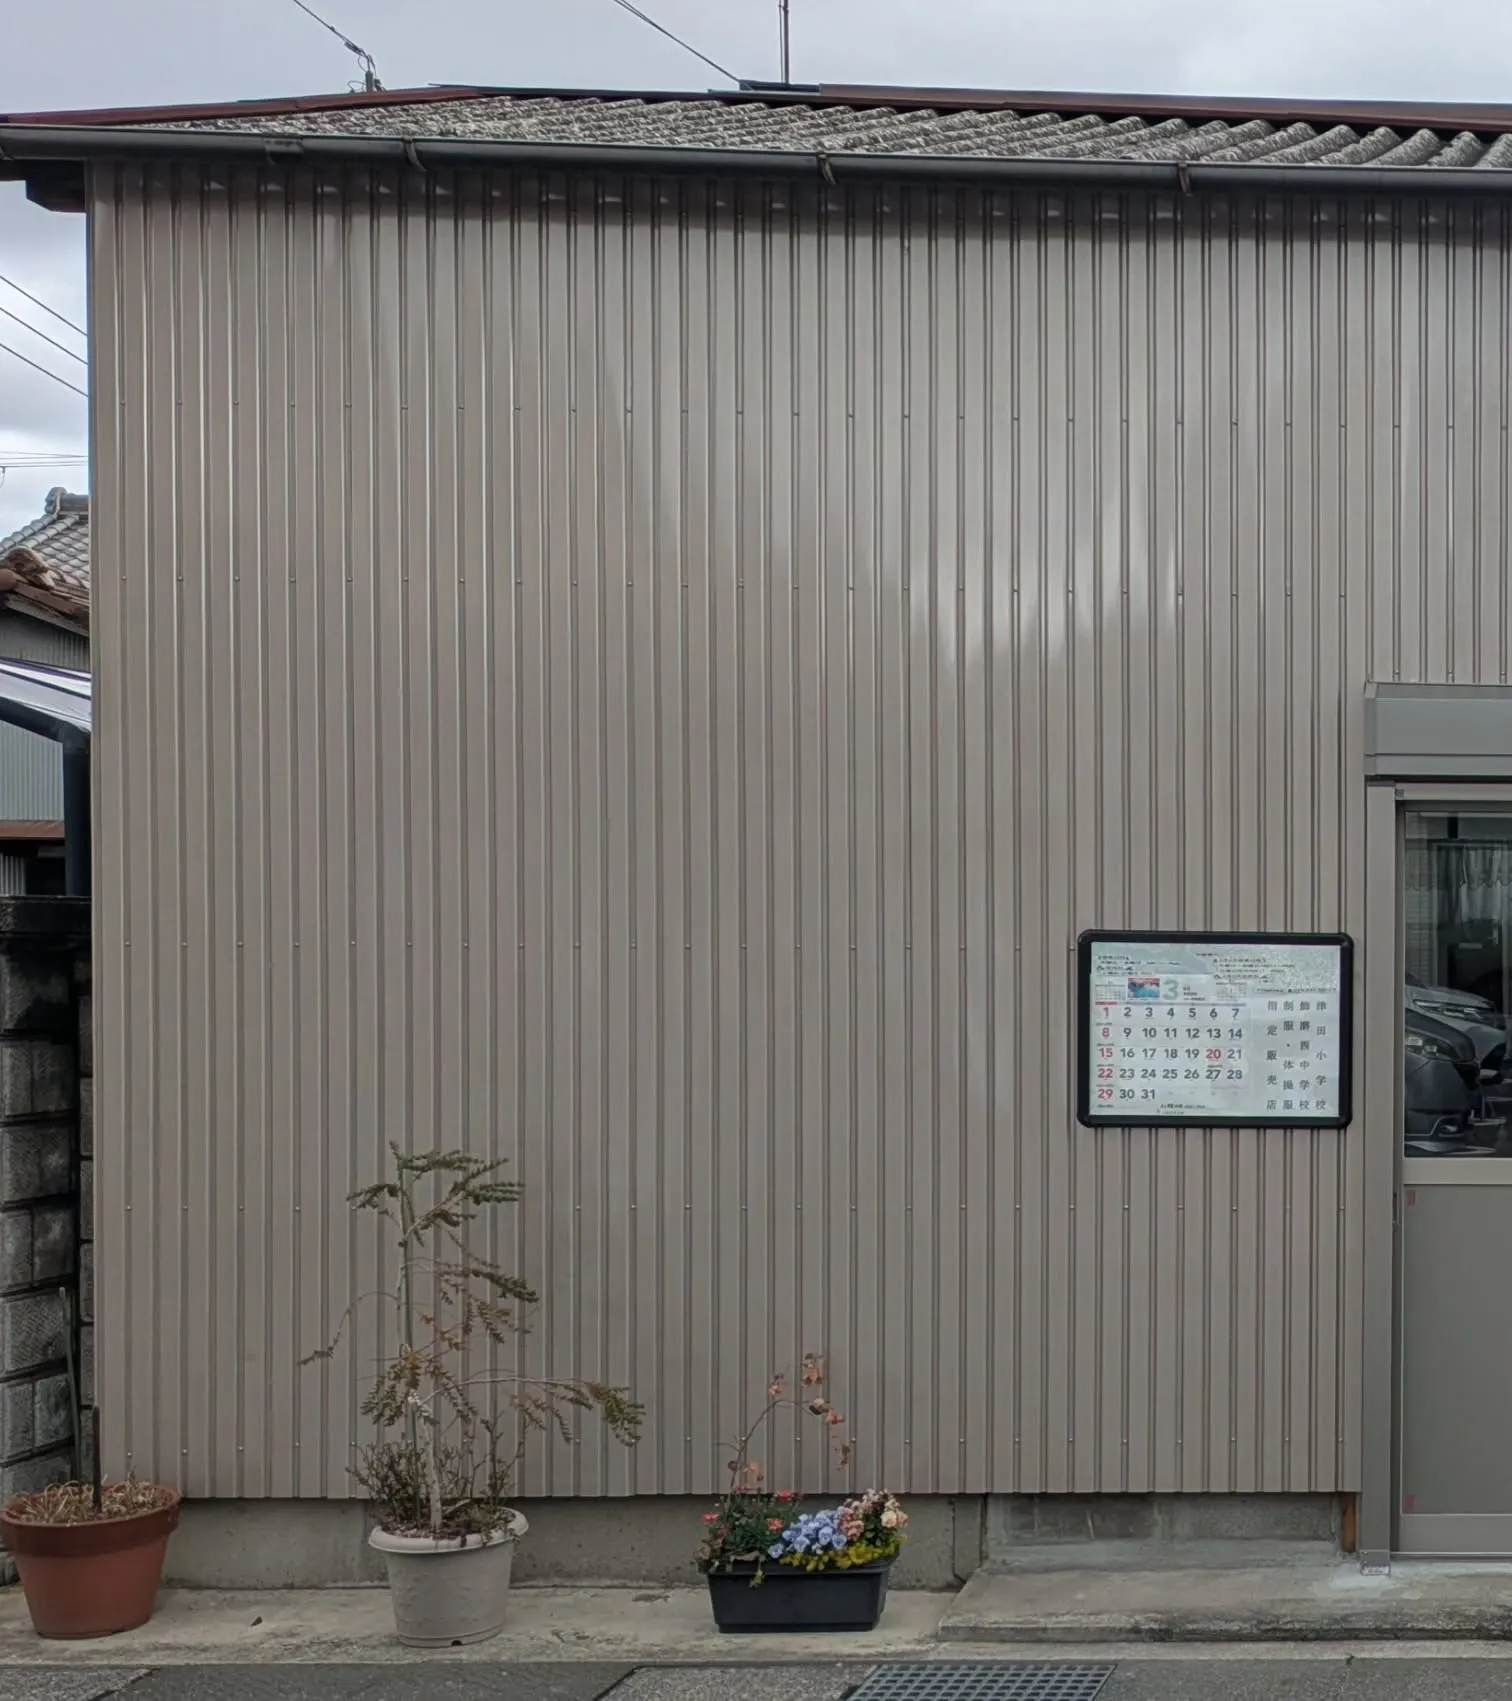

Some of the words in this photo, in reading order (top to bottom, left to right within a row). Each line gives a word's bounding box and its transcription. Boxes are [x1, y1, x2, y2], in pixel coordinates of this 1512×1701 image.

[1163, 979, 1178, 1000] 3
[1103, 1007, 1109, 1018] 1
[1123, 1007, 1132, 1018] 2
[1145, 1007, 1153, 1018] 3
[1166, 1007, 1175, 1018] 4
[1188, 1007, 1196, 1018] 5
[1209, 1007, 1218, 1018] 6
[1232, 1008, 1239, 1018] 7
[1102, 1027, 1110, 1038] 8
[1123, 1027, 1132, 1038] 9
[1142, 1027, 1157, 1038] 10
[1164, 1027, 1177, 1038] 11
[1185, 1027, 1200, 1038] 12
[1207, 1027, 1221, 1038] 13
[1228, 1028, 1243, 1039] 14
[1099, 1048, 1113, 1059] 15
[1120, 1048, 1134, 1059] 16
[1142, 1048, 1156, 1059] 17
[1164, 1048, 1178, 1059] 18
[1185, 1048, 1200, 1059] 19
[1206, 1048, 1221, 1059] 20
[1227, 1048, 1242, 1059] 21
[1097, 1069, 1113, 1080] 22
[1119, 1069, 1134, 1080] 23
[1141, 1069, 1156, 1080] 24
[1162, 1069, 1178, 1080] 25
[1184, 1069, 1200, 1080] 26
[1205, 1069, 1221, 1080] 27
[1227, 1069, 1243, 1080] 28
[1097, 1089, 1113, 1100] 29
[1119, 1089, 1135, 1100] 30
[1141, 1089, 1155, 1100] 31
